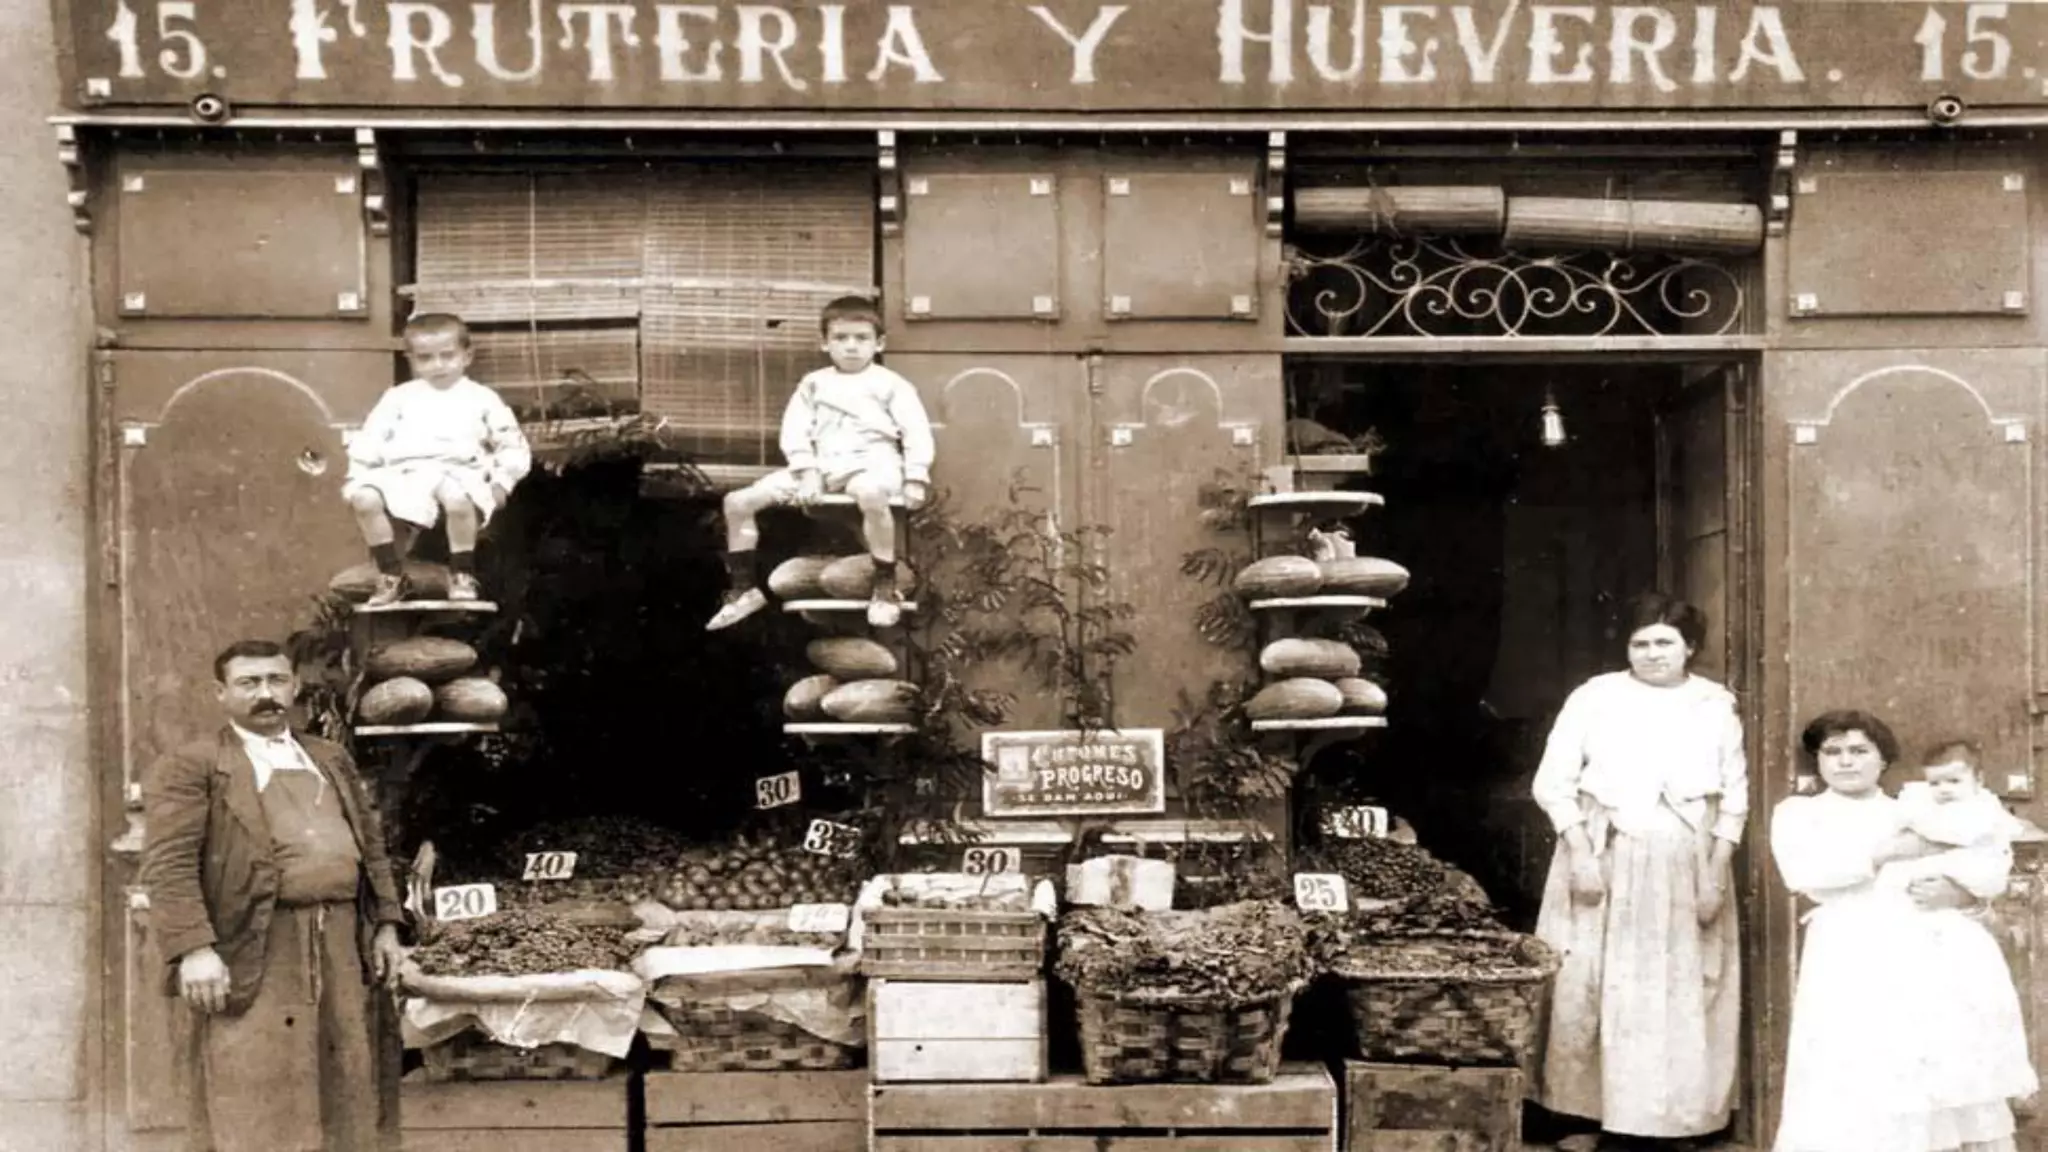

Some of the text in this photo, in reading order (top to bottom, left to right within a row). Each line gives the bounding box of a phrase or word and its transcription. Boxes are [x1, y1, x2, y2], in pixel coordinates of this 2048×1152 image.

[289, 0, 943, 88] FRUTERIA
[1027, 4, 1128, 84] Y
[1215, 0, 1843, 92] HUEVERIA.
[760, 776, 789, 806] 30
[1040, 765, 1144, 791] PROGRESO
[528, 853, 565, 878] 40
[966, 849, 1008, 875] 30
[441, 888, 486, 918] 20
[1301, 878, 1337, 907] 25
